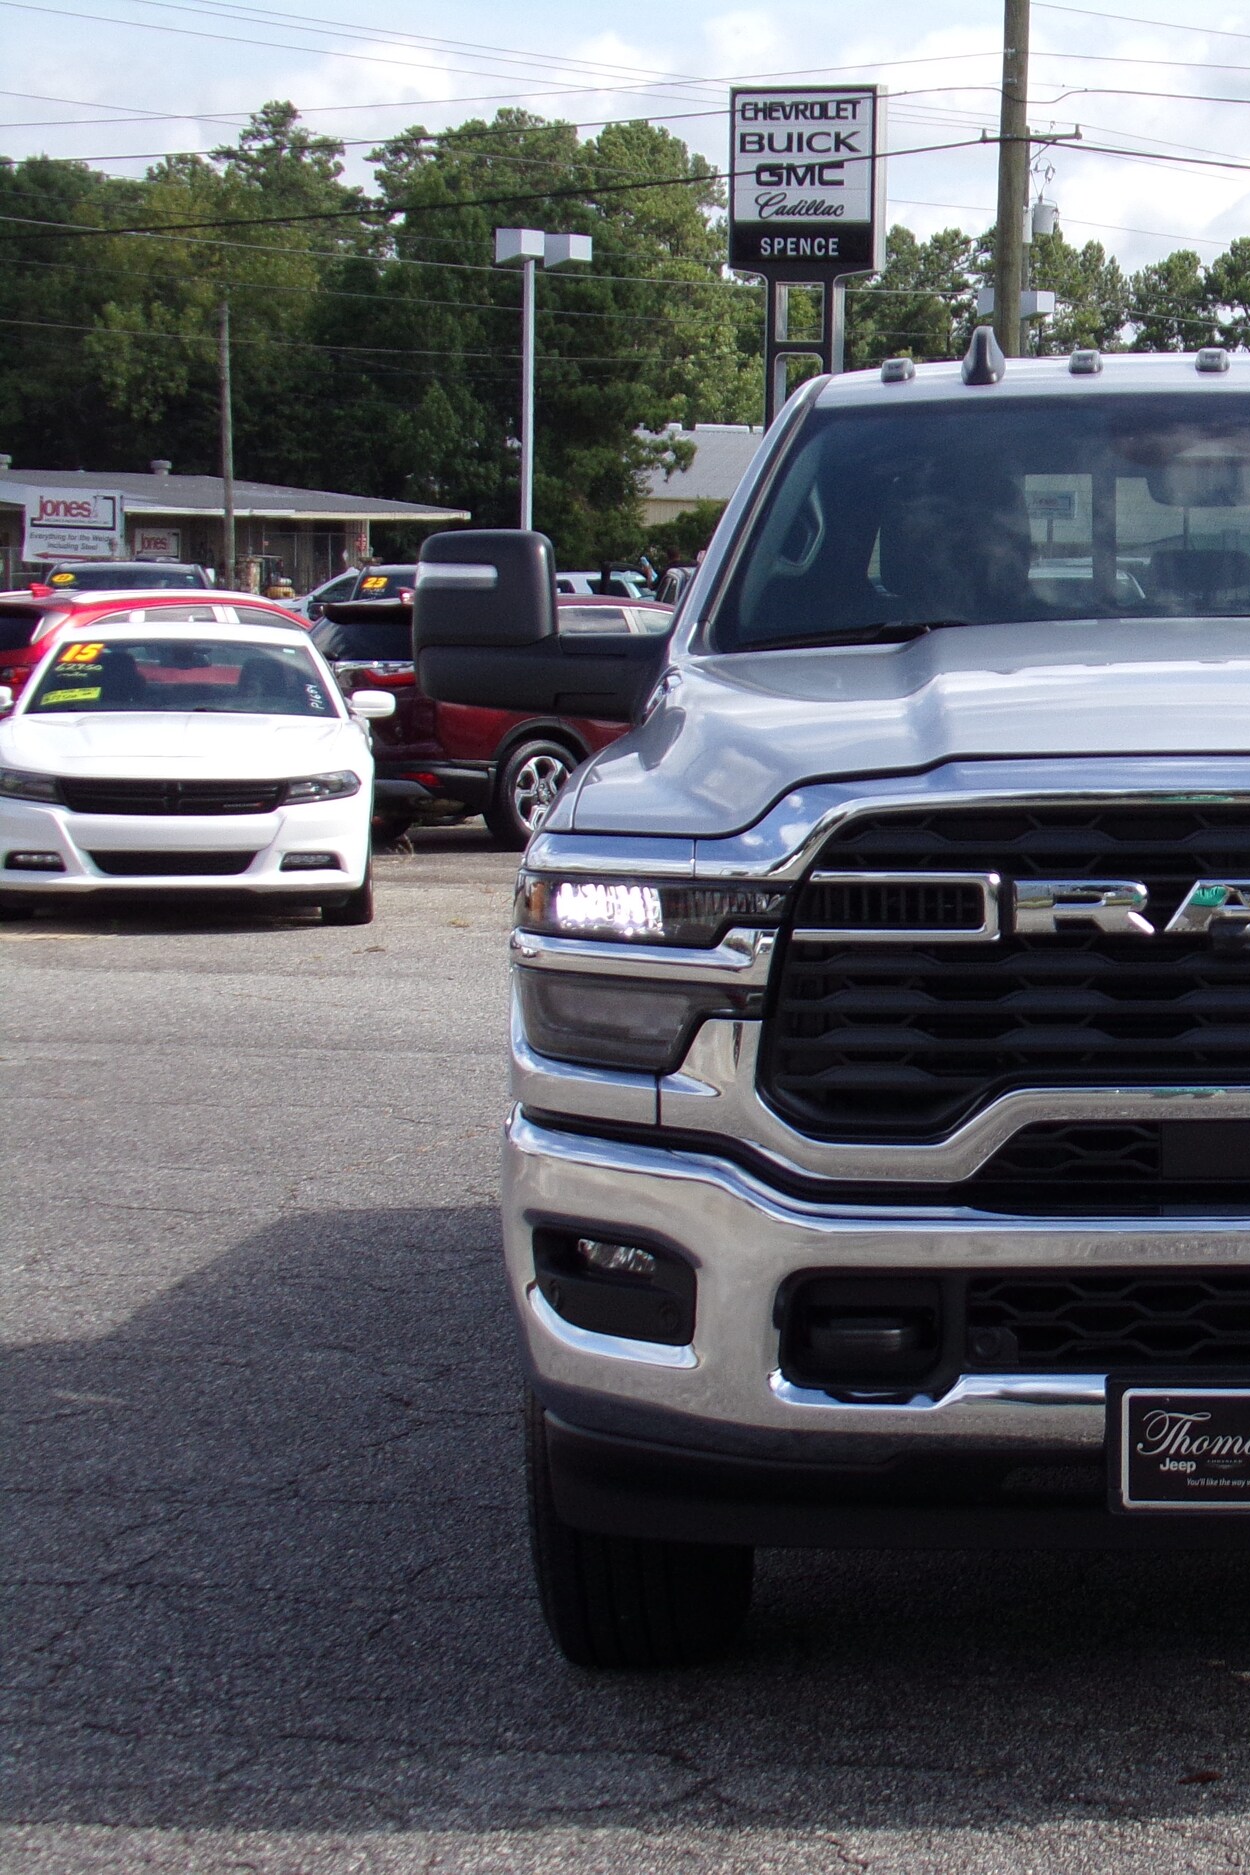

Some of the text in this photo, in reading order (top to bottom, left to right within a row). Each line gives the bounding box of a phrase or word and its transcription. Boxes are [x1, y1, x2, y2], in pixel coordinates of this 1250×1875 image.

[741, 100, 861, 121] CHEVROLET
[740, 131, 861, 153] BUICK
[755, 163, 845, 186] GMC
[755, 192, 844, 219] Cadillac
[760, 237, 839, 256] SPENCE
[67, 533, 79, 542] for
[79, 534, 91, 543] the
[362, 577, 388, 588] 23
[60, 643, 105, 662] 15
[1159, 1457, 1197, 1474] Jeep
[1186, 1477, 1205, 1486] You'll
[1206, 1477, 1218, 1486] like
[1219, 1477, 1231, 1486] the
[1231, 1479, 1246, 1488] way
